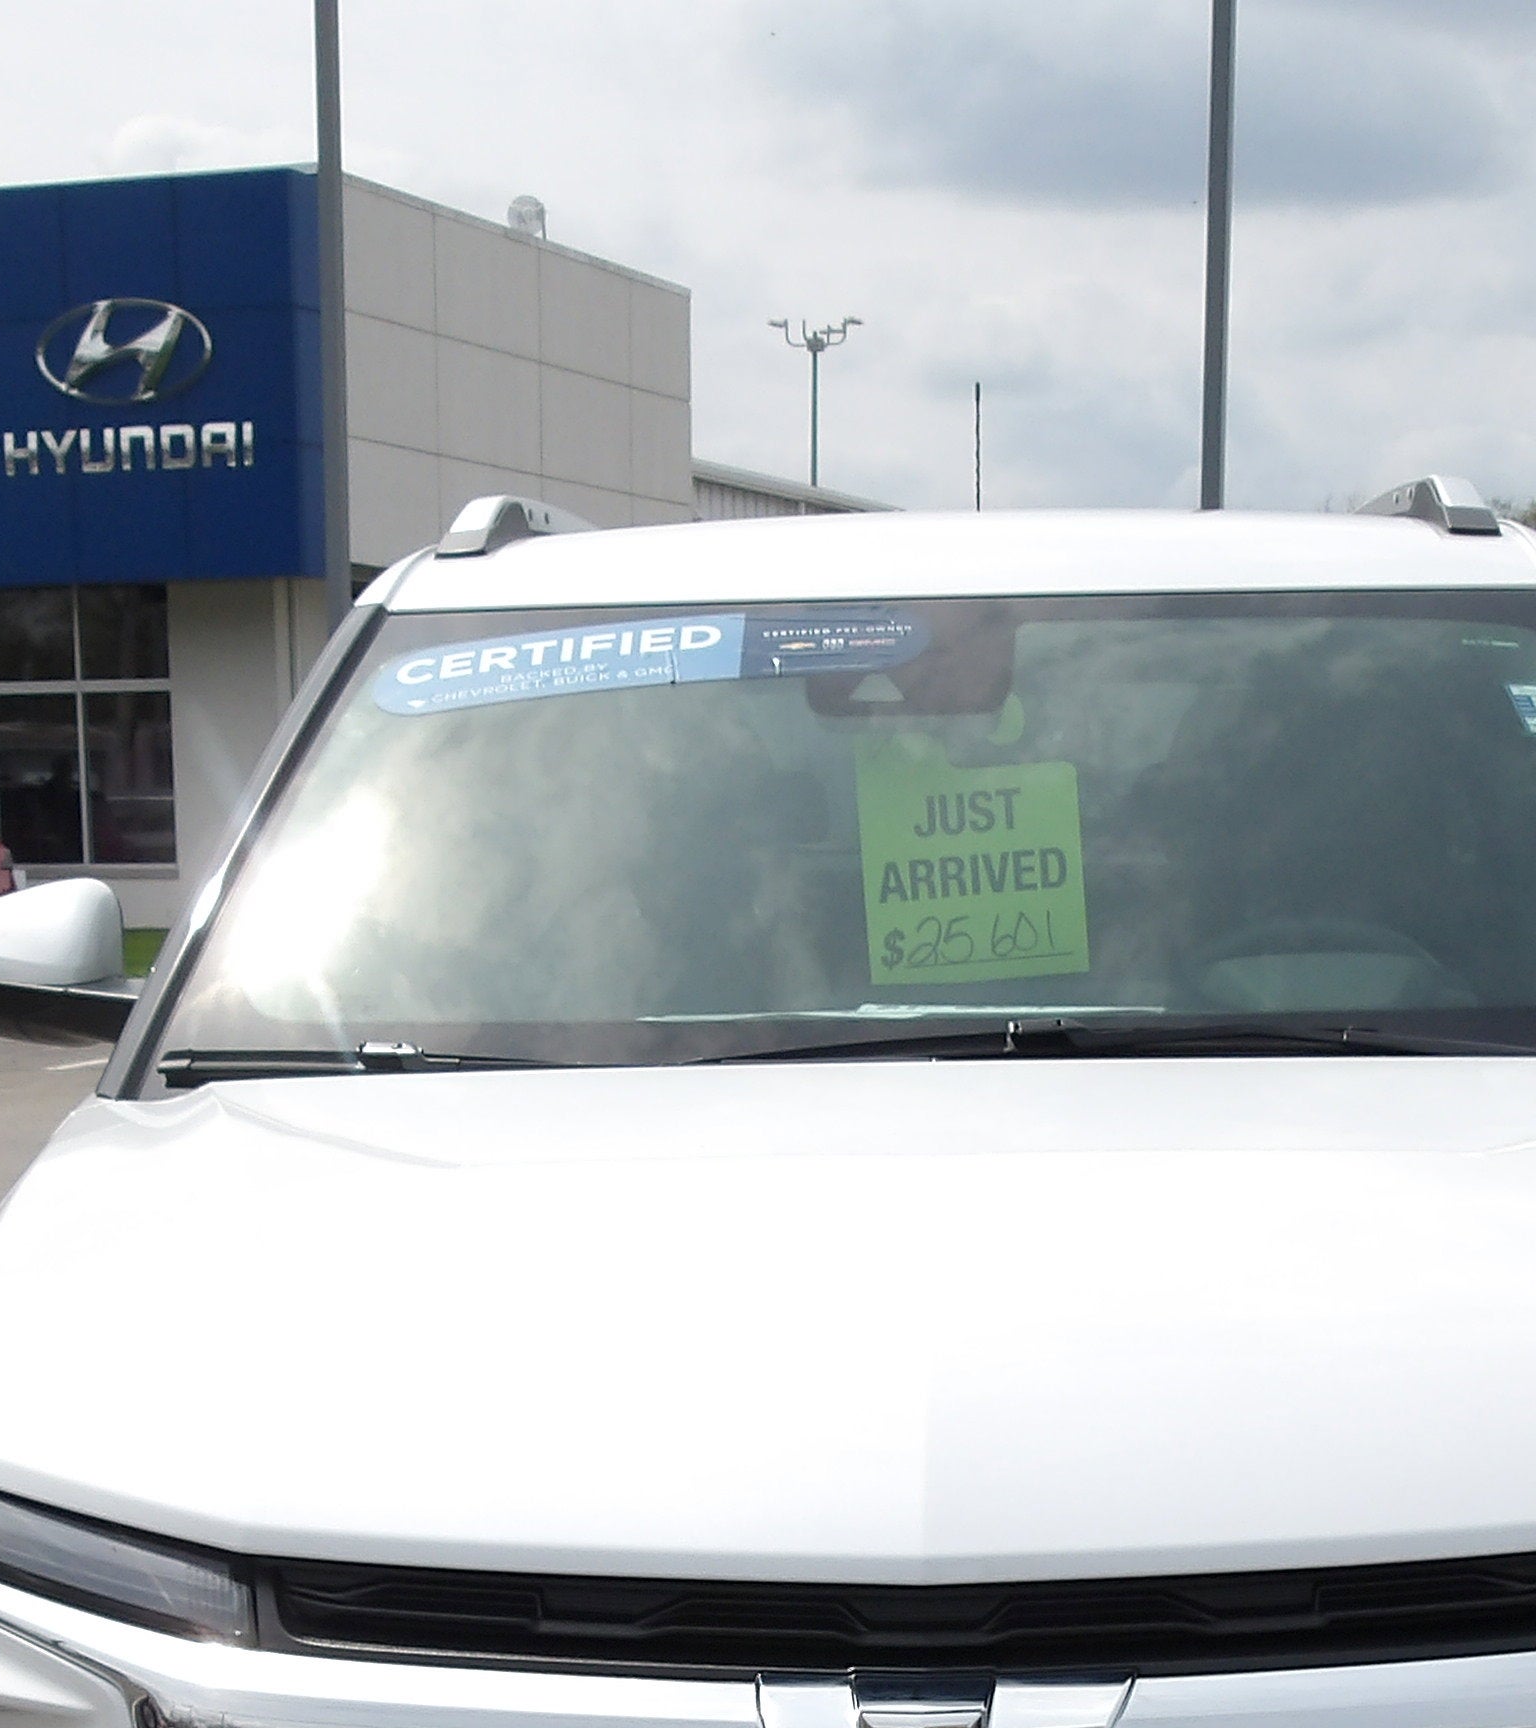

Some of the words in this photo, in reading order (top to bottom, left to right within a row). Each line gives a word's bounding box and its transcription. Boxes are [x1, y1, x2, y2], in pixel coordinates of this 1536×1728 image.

[3, 421, 254, 477] HYUNDAI
[396, 625, 722, 686] CERTIFIED
[500, 665, 577, 684] BACKED
[584, 662, 608, 673] BY
[553, 672, 610, 687] BUICK
[913, 787, 1021, 838] JUST
[879, 847, 1068, 904] ARRIVED
